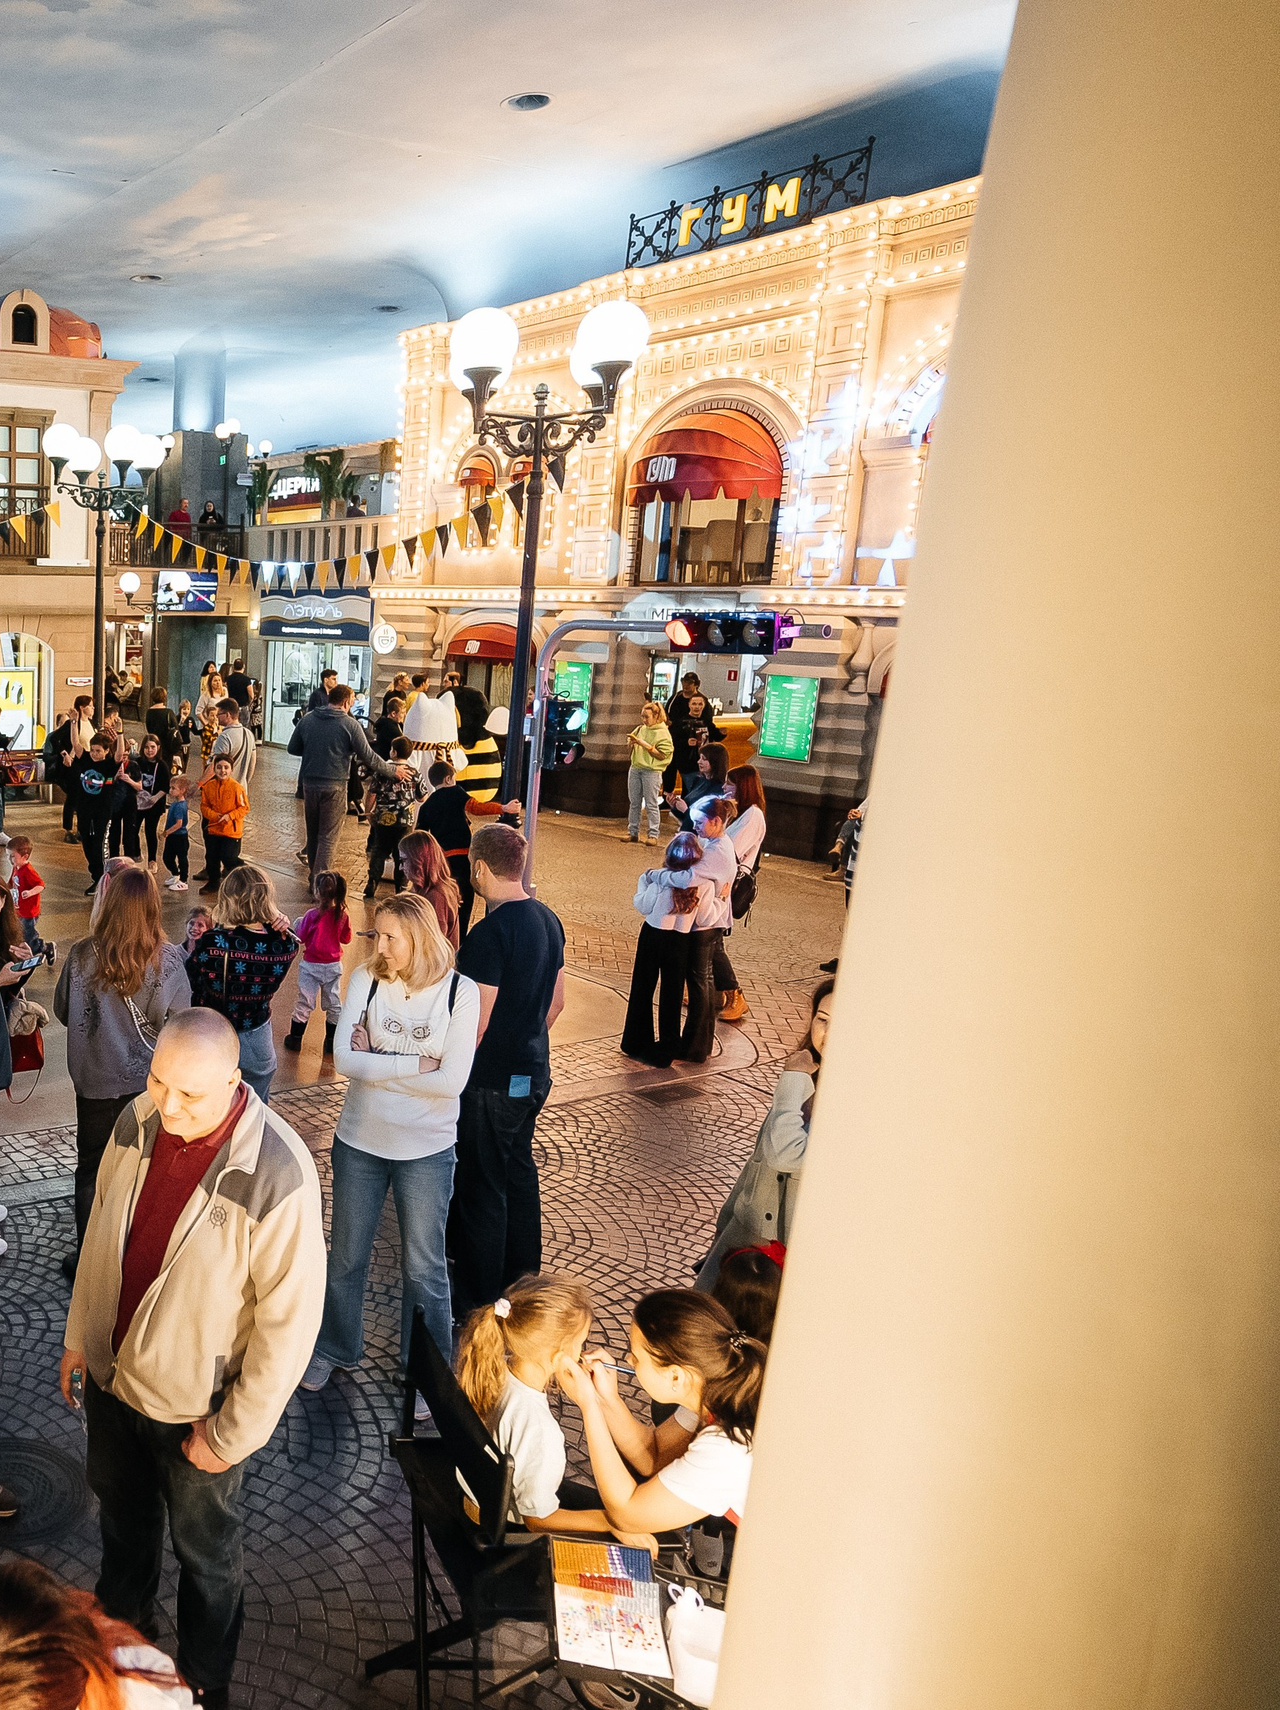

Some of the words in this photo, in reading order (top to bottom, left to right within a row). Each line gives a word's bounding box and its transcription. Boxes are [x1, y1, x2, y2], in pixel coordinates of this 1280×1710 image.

[678, 177, 801, 247] ГУМ
[209, 949, 225, 957] LOV
[230, 951, 250, 959] LOVE
